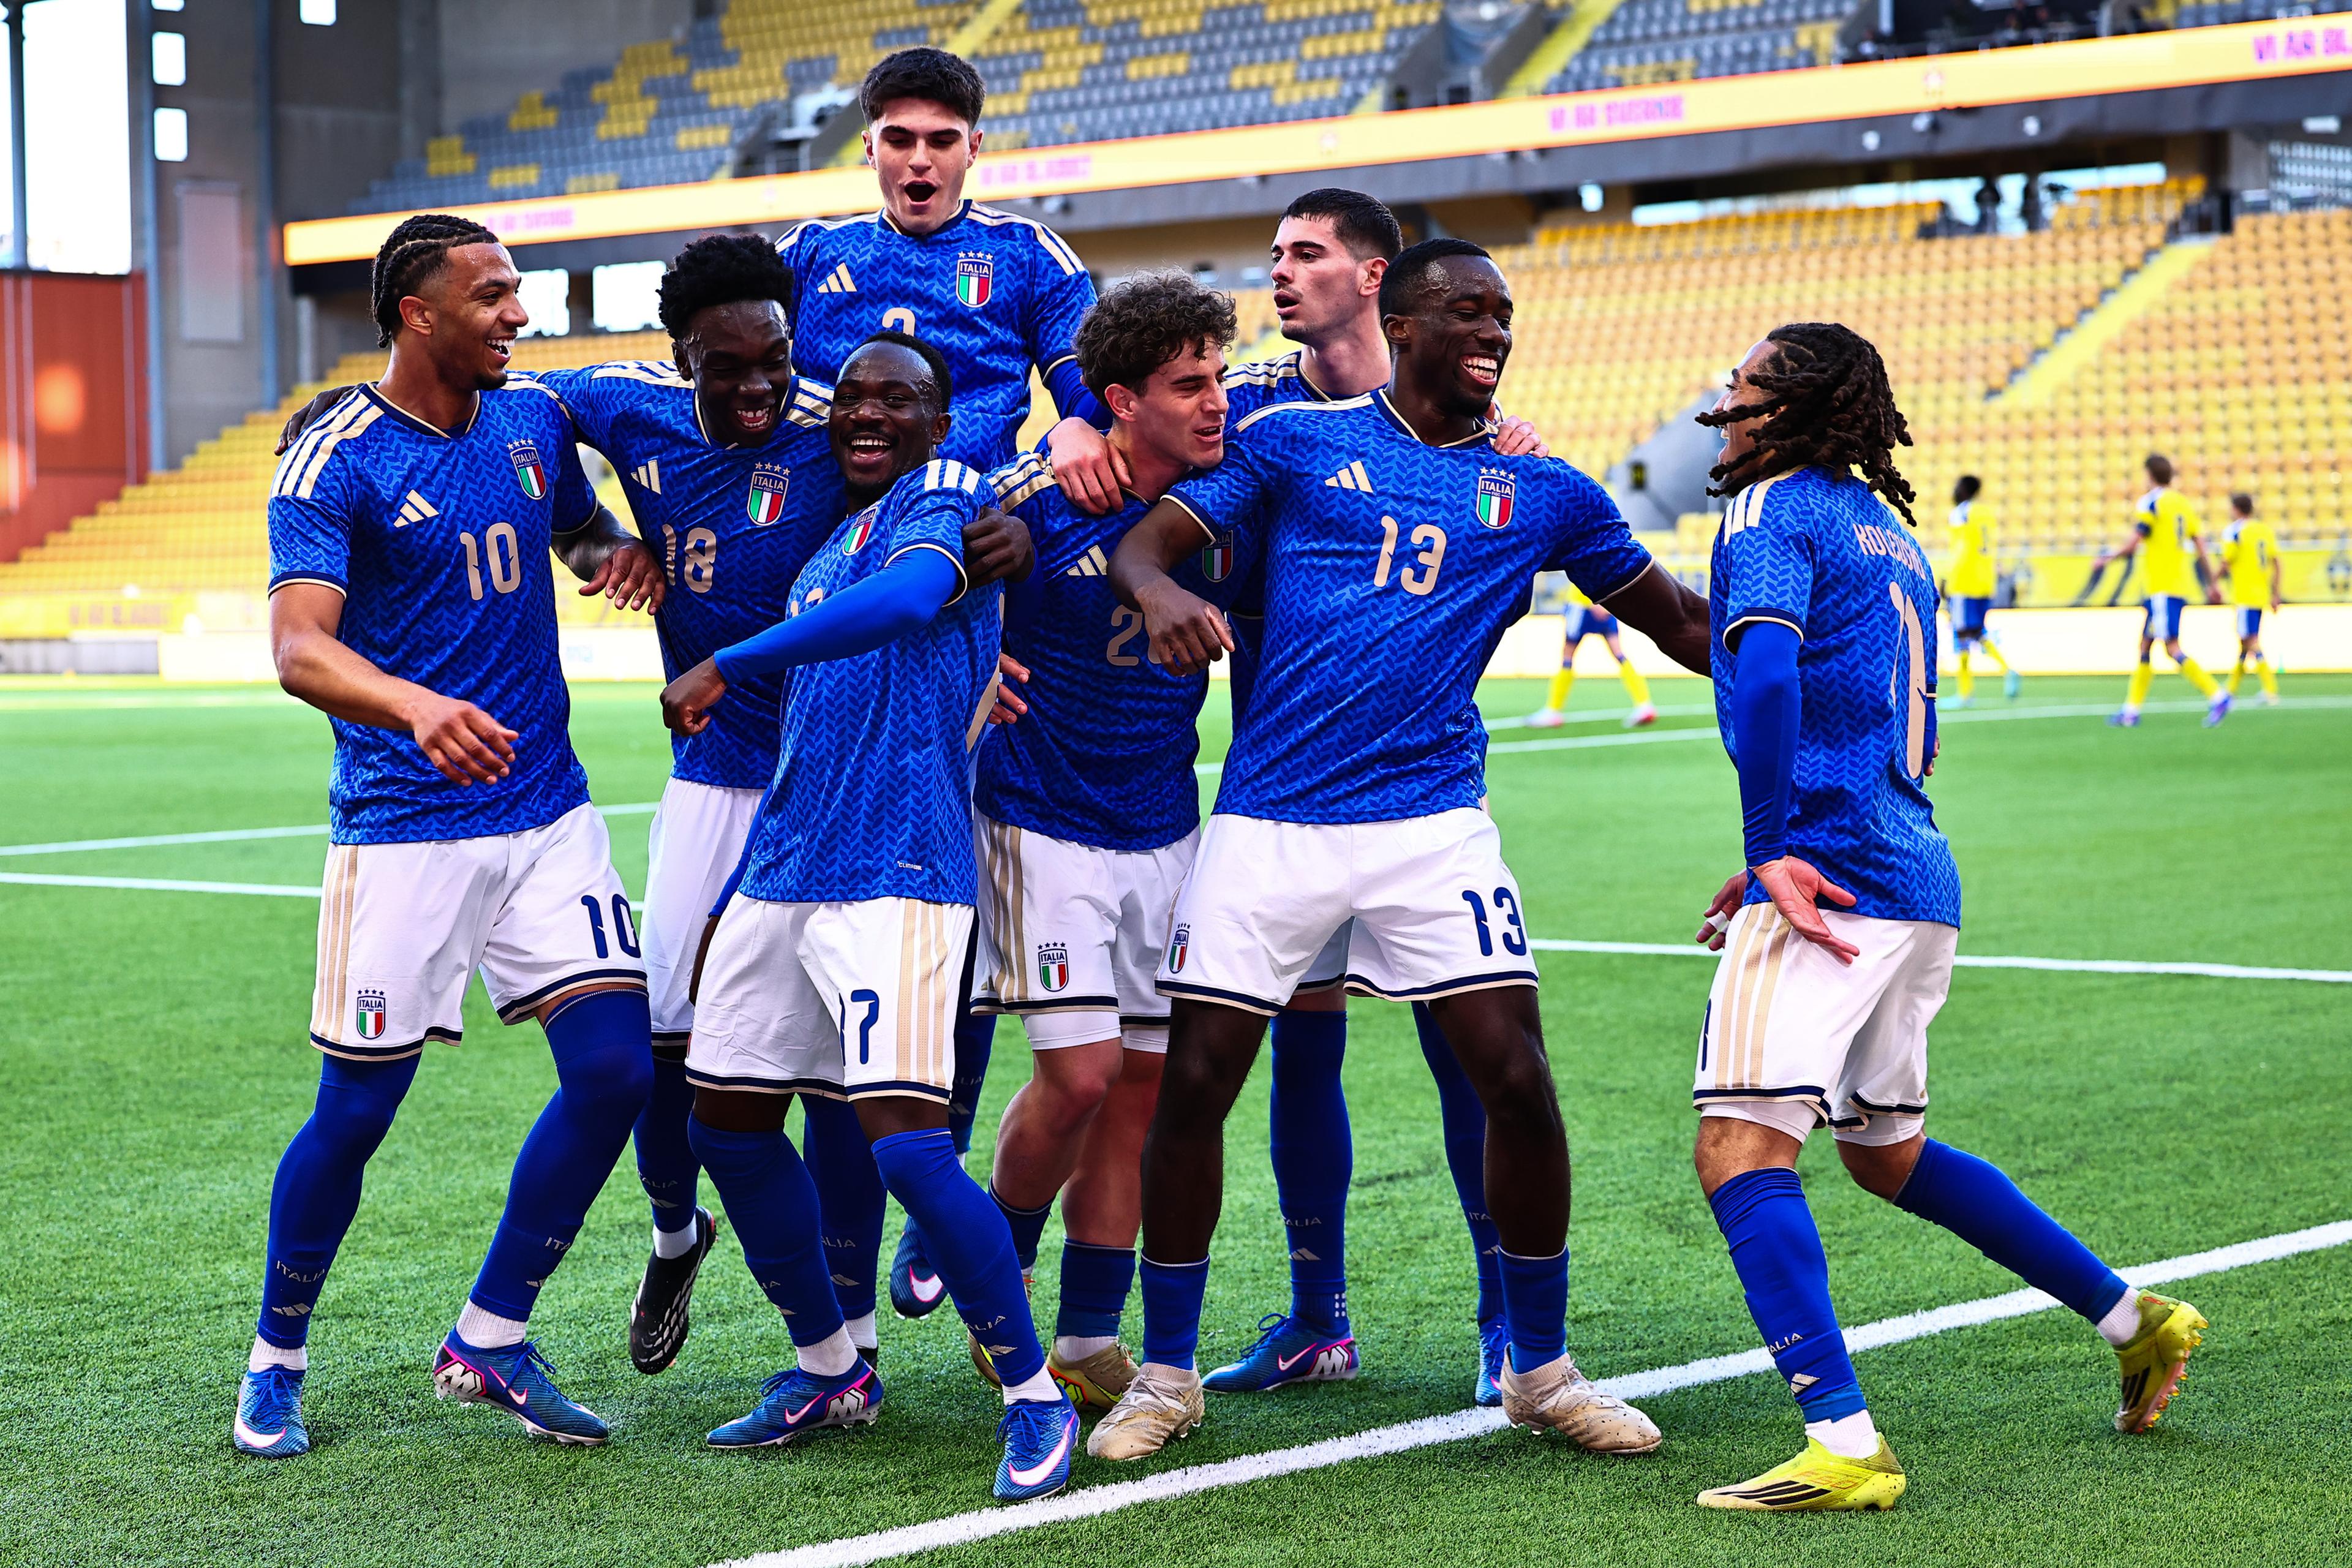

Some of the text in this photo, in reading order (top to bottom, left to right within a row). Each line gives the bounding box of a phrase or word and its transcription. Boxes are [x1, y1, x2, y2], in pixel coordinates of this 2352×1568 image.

[960, 263, 989, 274] ITALIA
[513, 452, 537, 465] ITALIA
[754, 475, 783, 490] ITALIA
[1481, 480, 1512, 495] ITALIA
[459, 522, 521, 601] 10
[662, 523, 717, 594] 18
[1373, 515, 1447, 595] 13
[1106, 605, 1162, 666] 2
[581, 893, 641, 959] 10
[1462, 886, 1526, 957] 13
[1040, 952, 1065, 962] ITALIA
[359, 1000, 383, 1008] ITALIA
[641, 1176, 679, 1189] ALIA
[1468, 1212, 1492, 1221] ITA
[545, 1237, 571, 1251] ITA
[1768, 1333, 1804, 1355] ALIA
